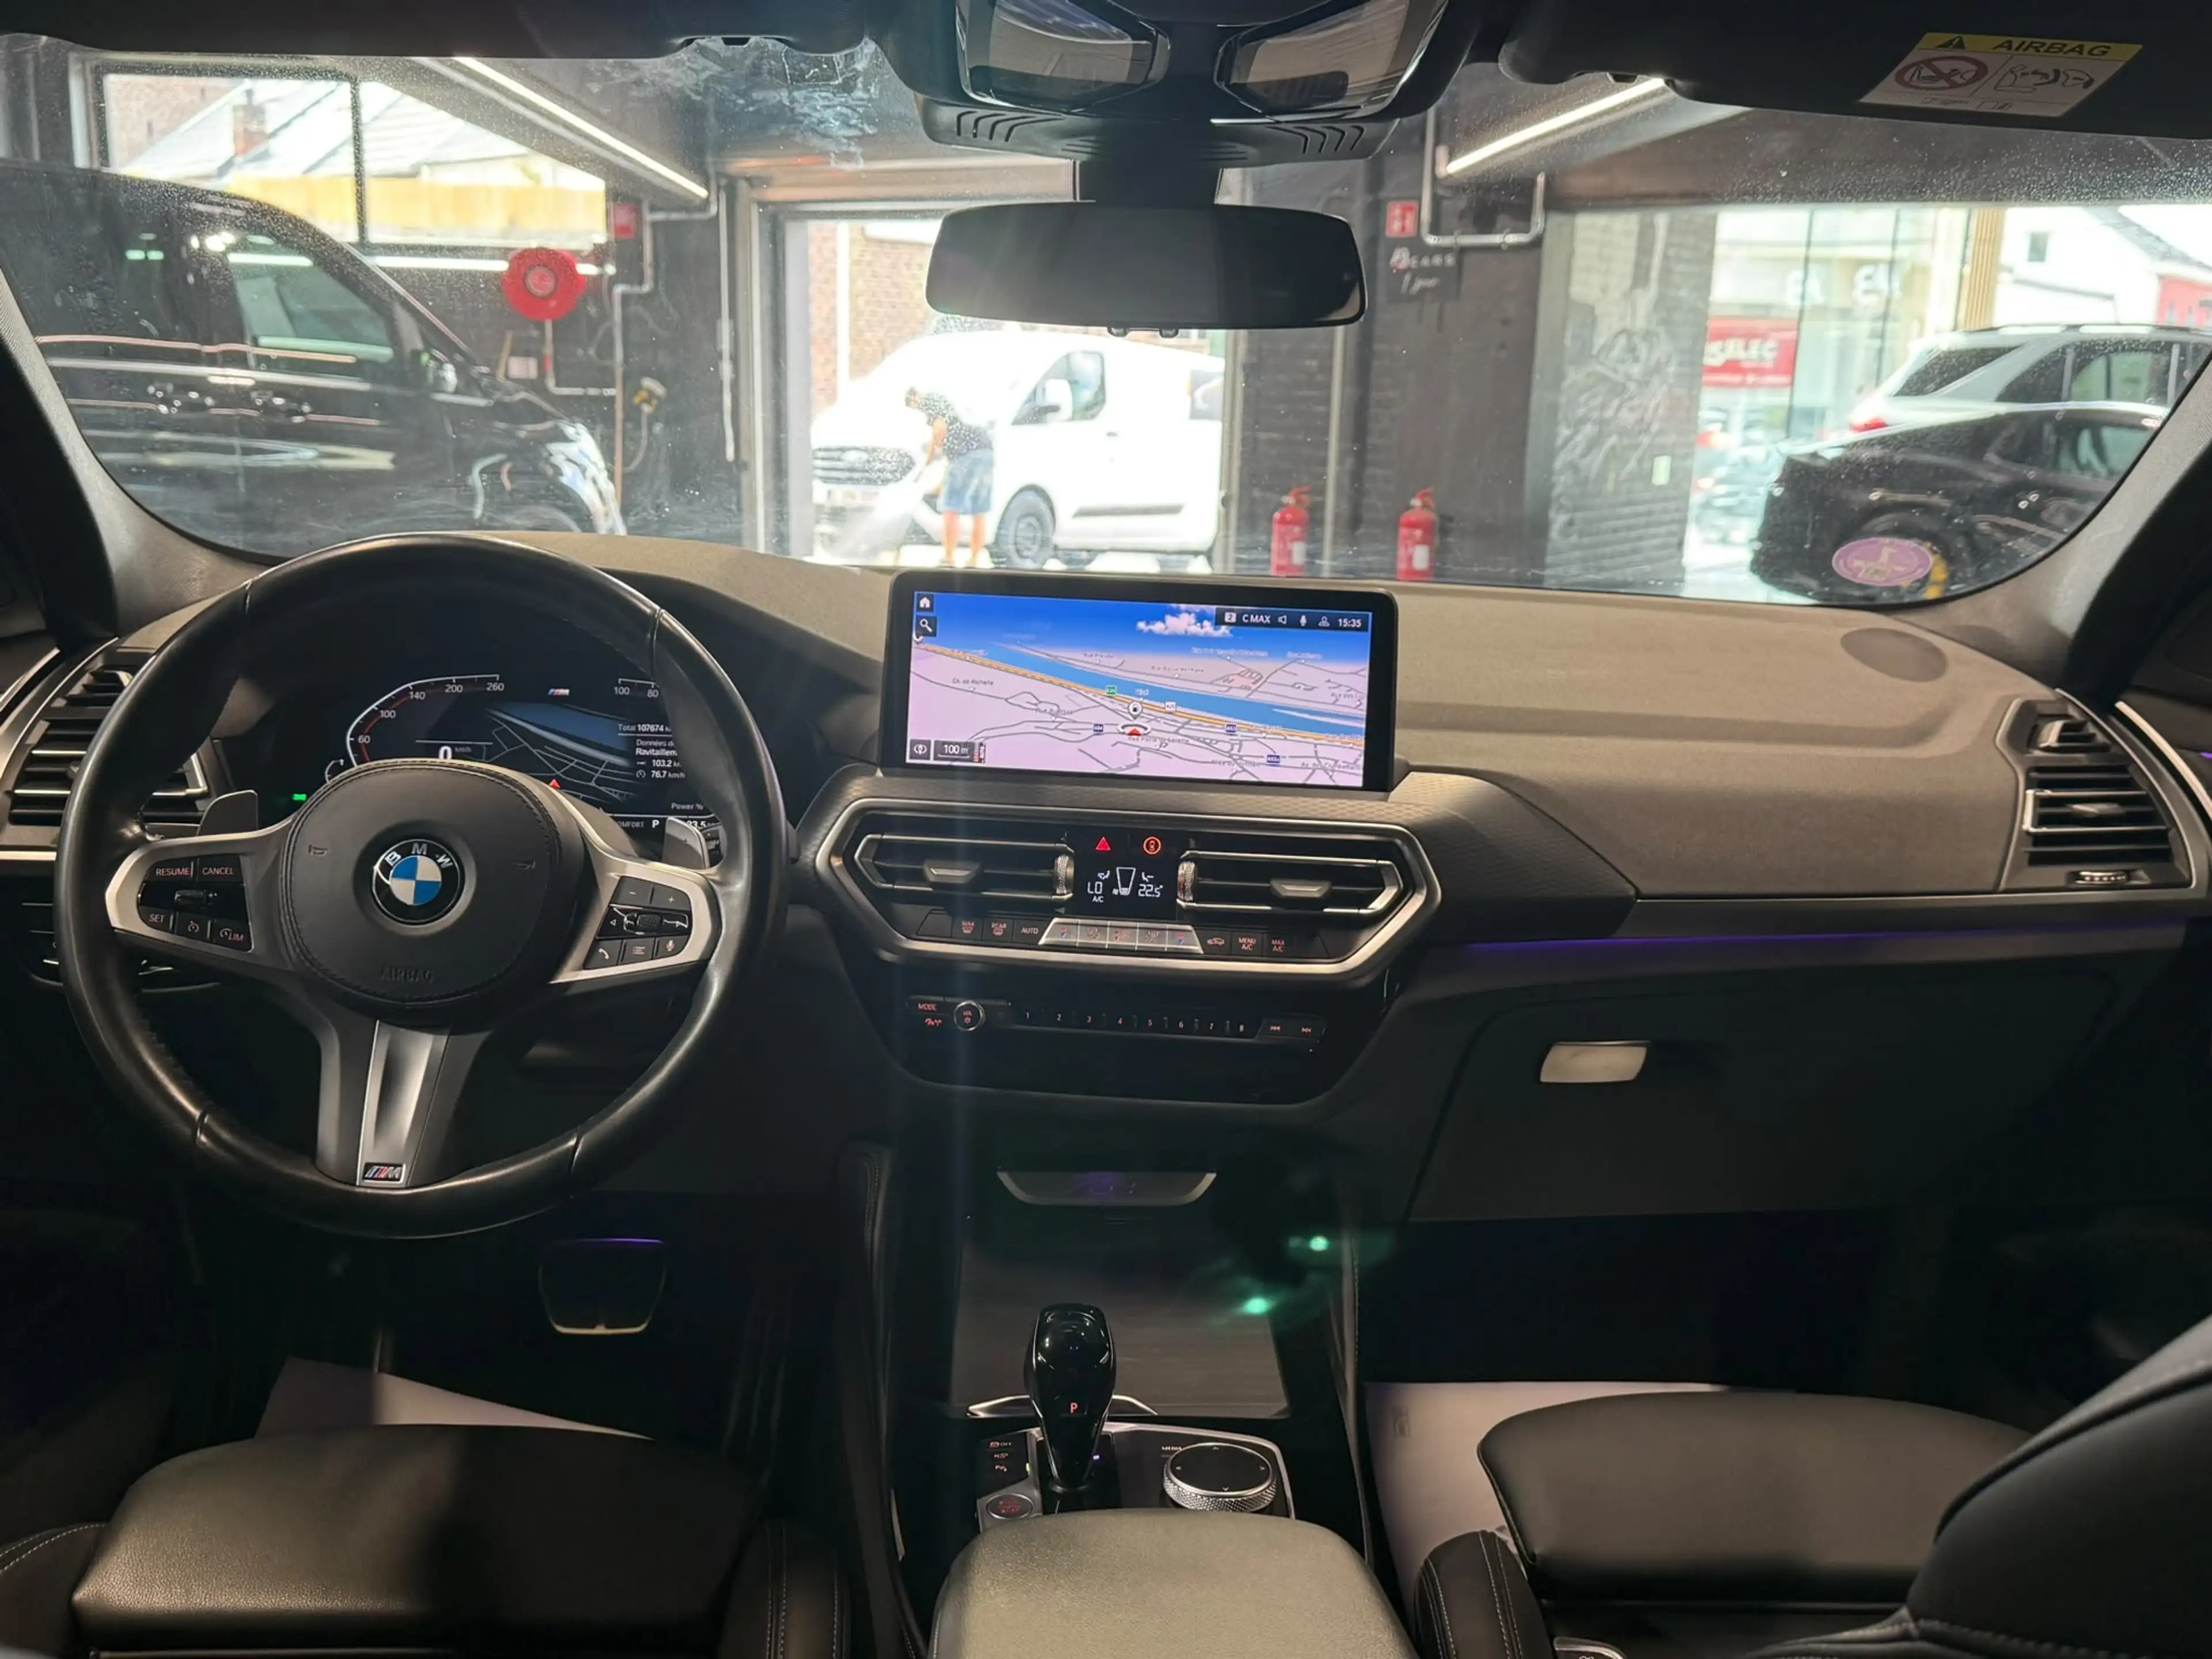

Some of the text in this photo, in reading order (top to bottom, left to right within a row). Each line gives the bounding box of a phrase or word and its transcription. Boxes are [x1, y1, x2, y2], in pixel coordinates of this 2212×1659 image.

[1992, 39, 2112, 57] AIRBAG
[1251, 615, 1271, 623] MAX
[1338, 619, 1362, 627] 15:35
[445, 684, 463, 693] 200
[487, 683, 505, 691] 260
[614, 687, 630, 695] 100
[410, 691, 426, 700] 140
[647, 689, 659, 698] 80
[380, 710, 396, 718] 100
[637, 724, 664, 732] 107674
[358, 735, 370, 744] 60
[438, 746, 453, 759] 0
[943, 745, 960, 753] 100
[652, 759, 672, 767] 103.2
[651, 770, 667, 778] 76.7
[652, 820, 660, 828] P
[385, 843, 453, 868] BMW
[156, 867, 233, 876] RESUME CANCEL
[149, 914, 244, 942] SET LIM
[380, 965, 435, 984] AIRBAG
[918, 1003, 937, 1011] MODE
[1118, 1017, 1123, 1025] 4
[1070, 1402, 1078, 1414] P
